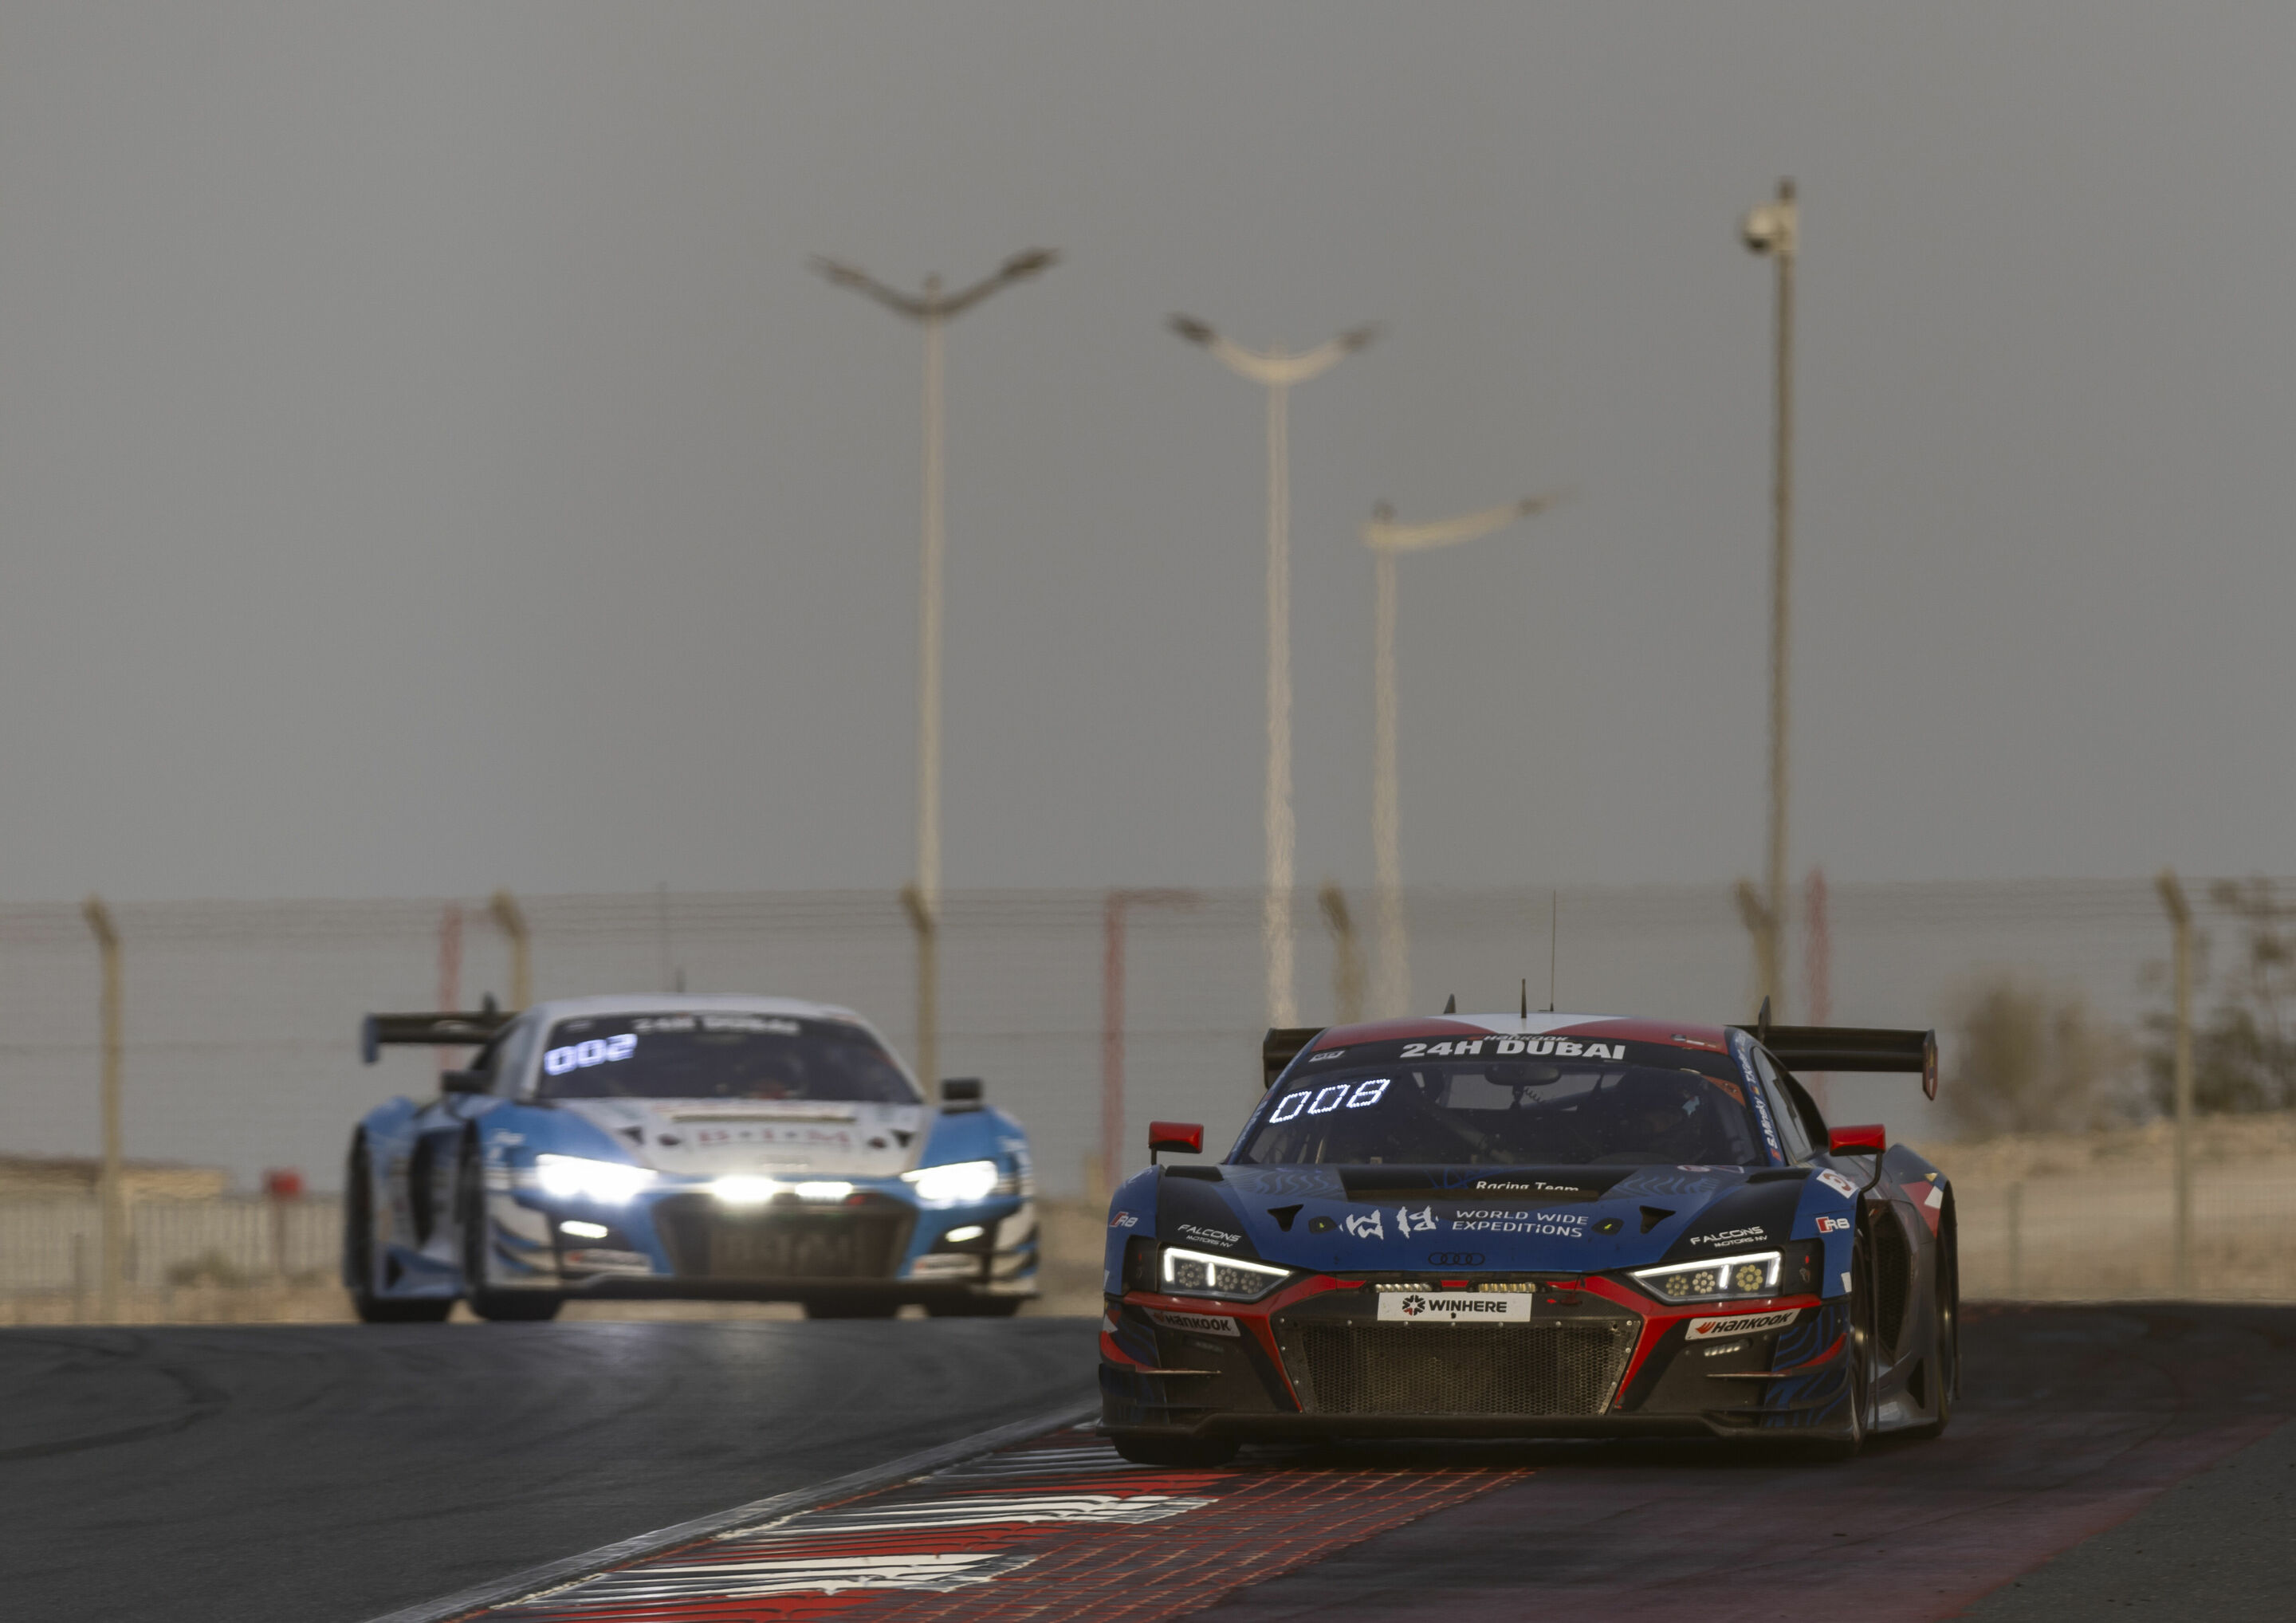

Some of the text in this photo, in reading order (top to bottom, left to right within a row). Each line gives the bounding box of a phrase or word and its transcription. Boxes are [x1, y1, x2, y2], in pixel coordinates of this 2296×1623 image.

[544, 1033, 637, 1075] 002
[1400, 1040, 1626, 1059] 24H DUBAI
[1269, 1079, 1390, 1123] 008
[1456, 1210, 1589, 1225] WORLD WIDE
[1177, 1224, 1241, 1242] FALCONS
[1186, 1236, 1220, 1245] MOTORS
[1689, 1226, 1764, 1245] FALCONS
[1429, 1299, 1508, 1313] WINHERE
